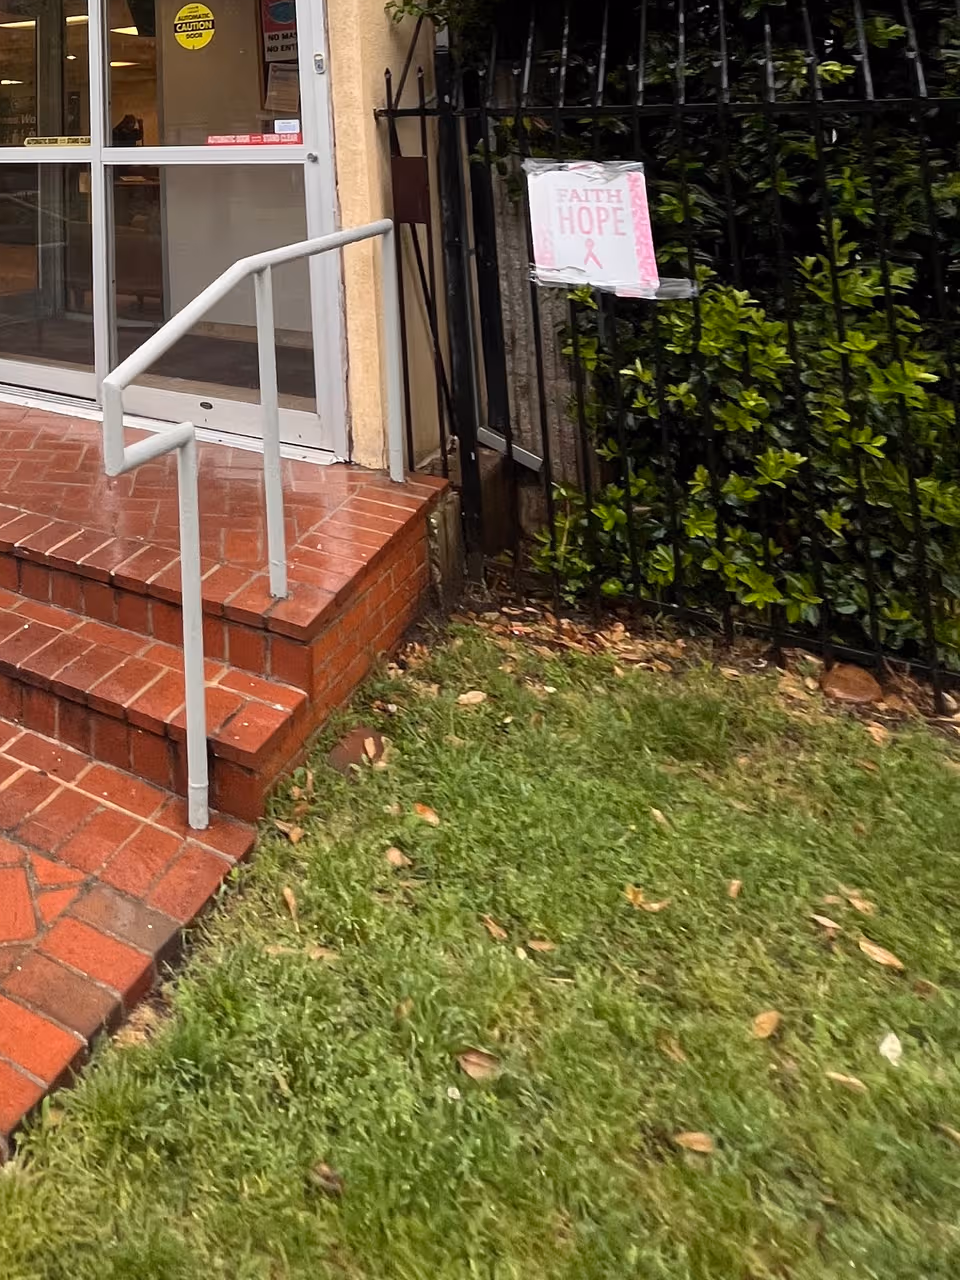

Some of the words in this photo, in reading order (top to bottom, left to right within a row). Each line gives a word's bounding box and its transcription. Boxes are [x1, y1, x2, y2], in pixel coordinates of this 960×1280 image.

[176, 21, 213, 32] CAUTION
[268, 33, 280, 41] NO
[282, 31, 297, 40] MAS
[267, 44, 278, 53] NO
[280, 43, 296, 52] ENT
[556, 189, 623, 203] FAITH
[557, 206, 627, 236] HOPE
